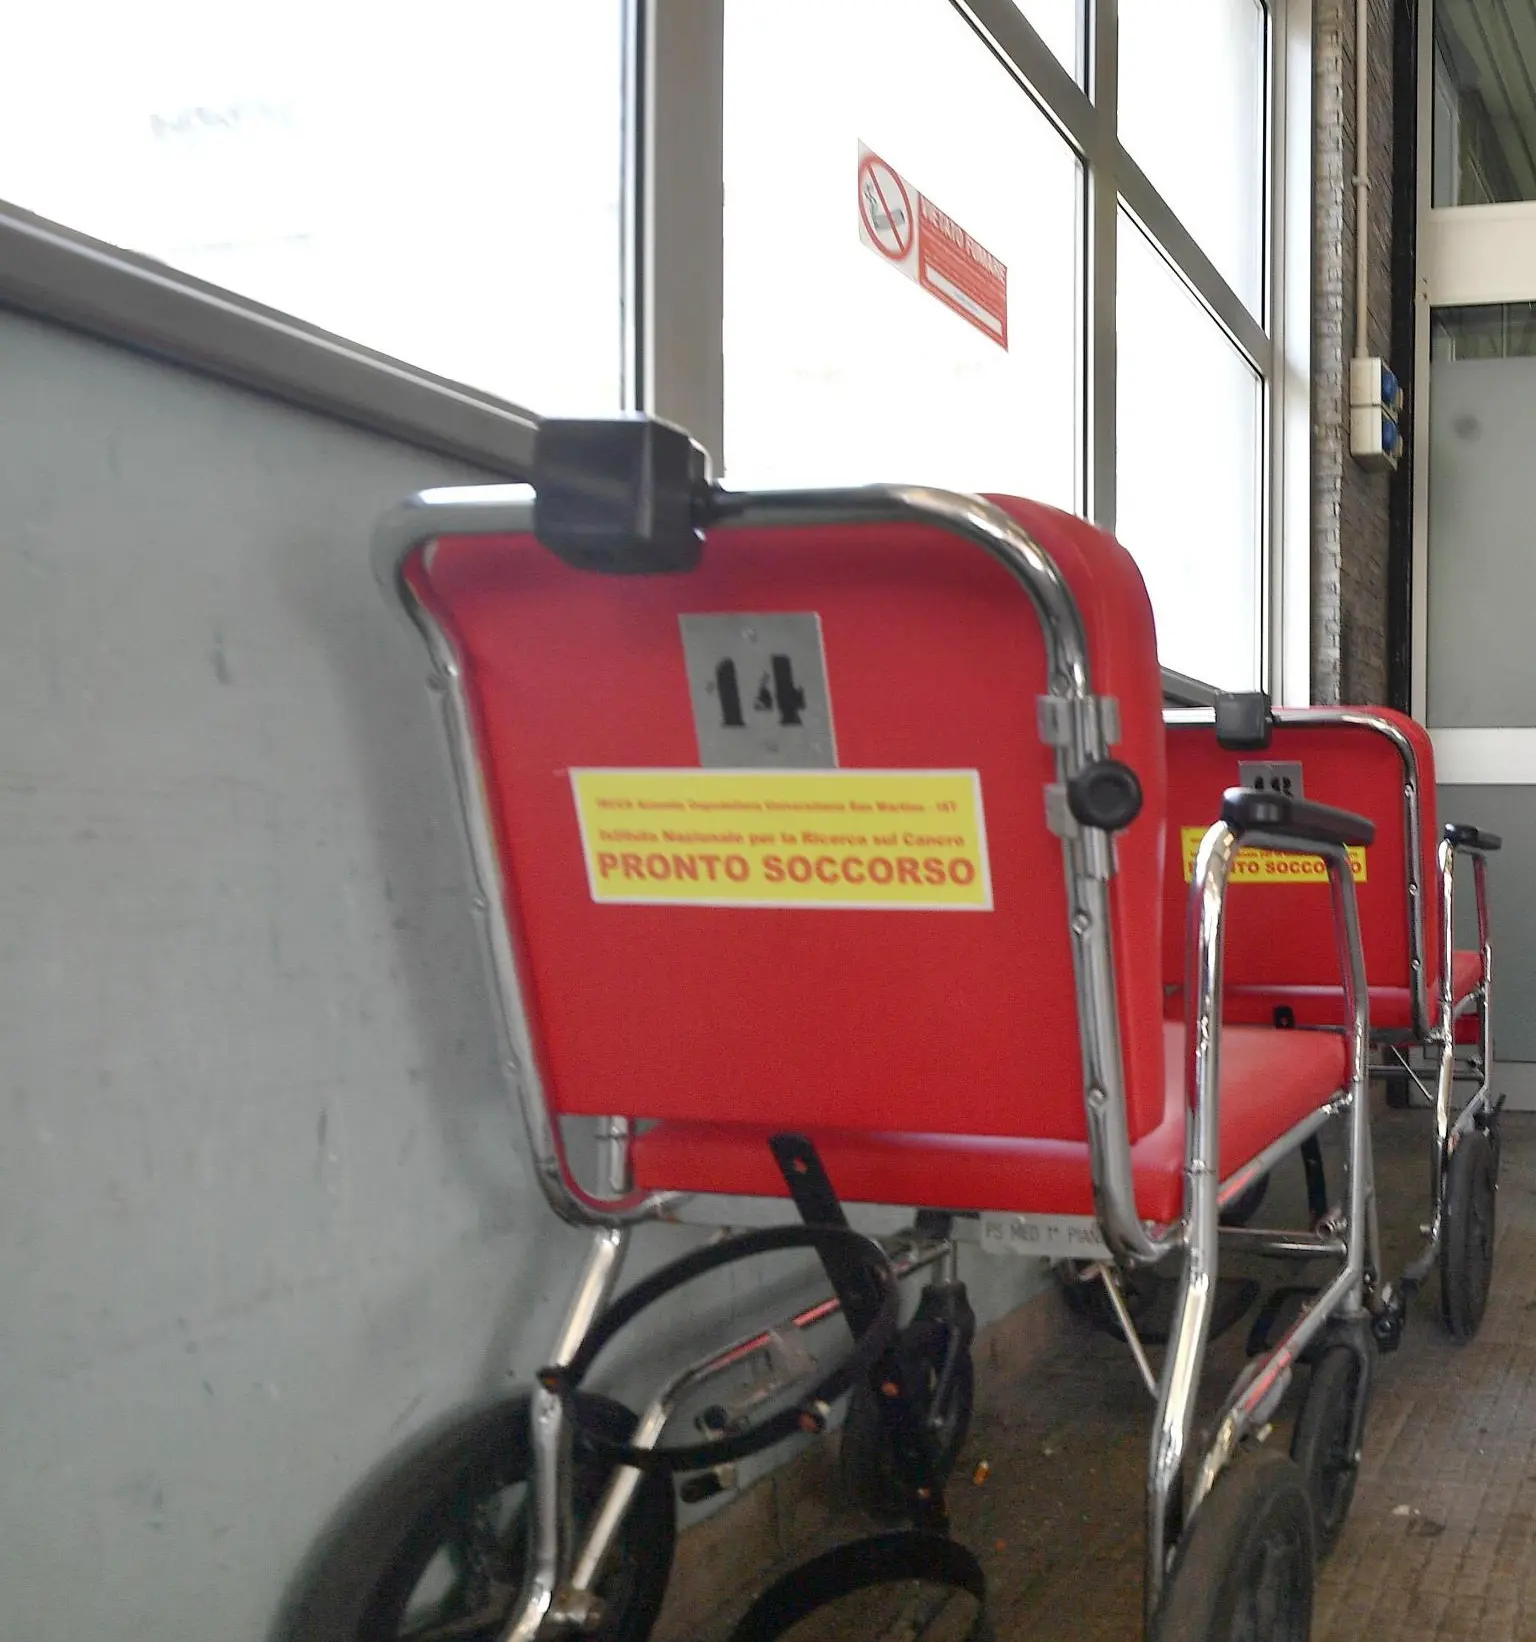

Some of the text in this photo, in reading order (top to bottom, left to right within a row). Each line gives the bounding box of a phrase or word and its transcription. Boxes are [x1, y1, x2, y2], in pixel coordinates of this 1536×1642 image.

[714, 653, 806, 728] 14
[749, 832, 775, 847] per
[780, 832, 797, 844] la
[801, 831, 867, 846] Ricerca
[597, 852, 975, 886] PRONTO SOCCORSO
[1266, 861, 1362, 875] SOCCOO
